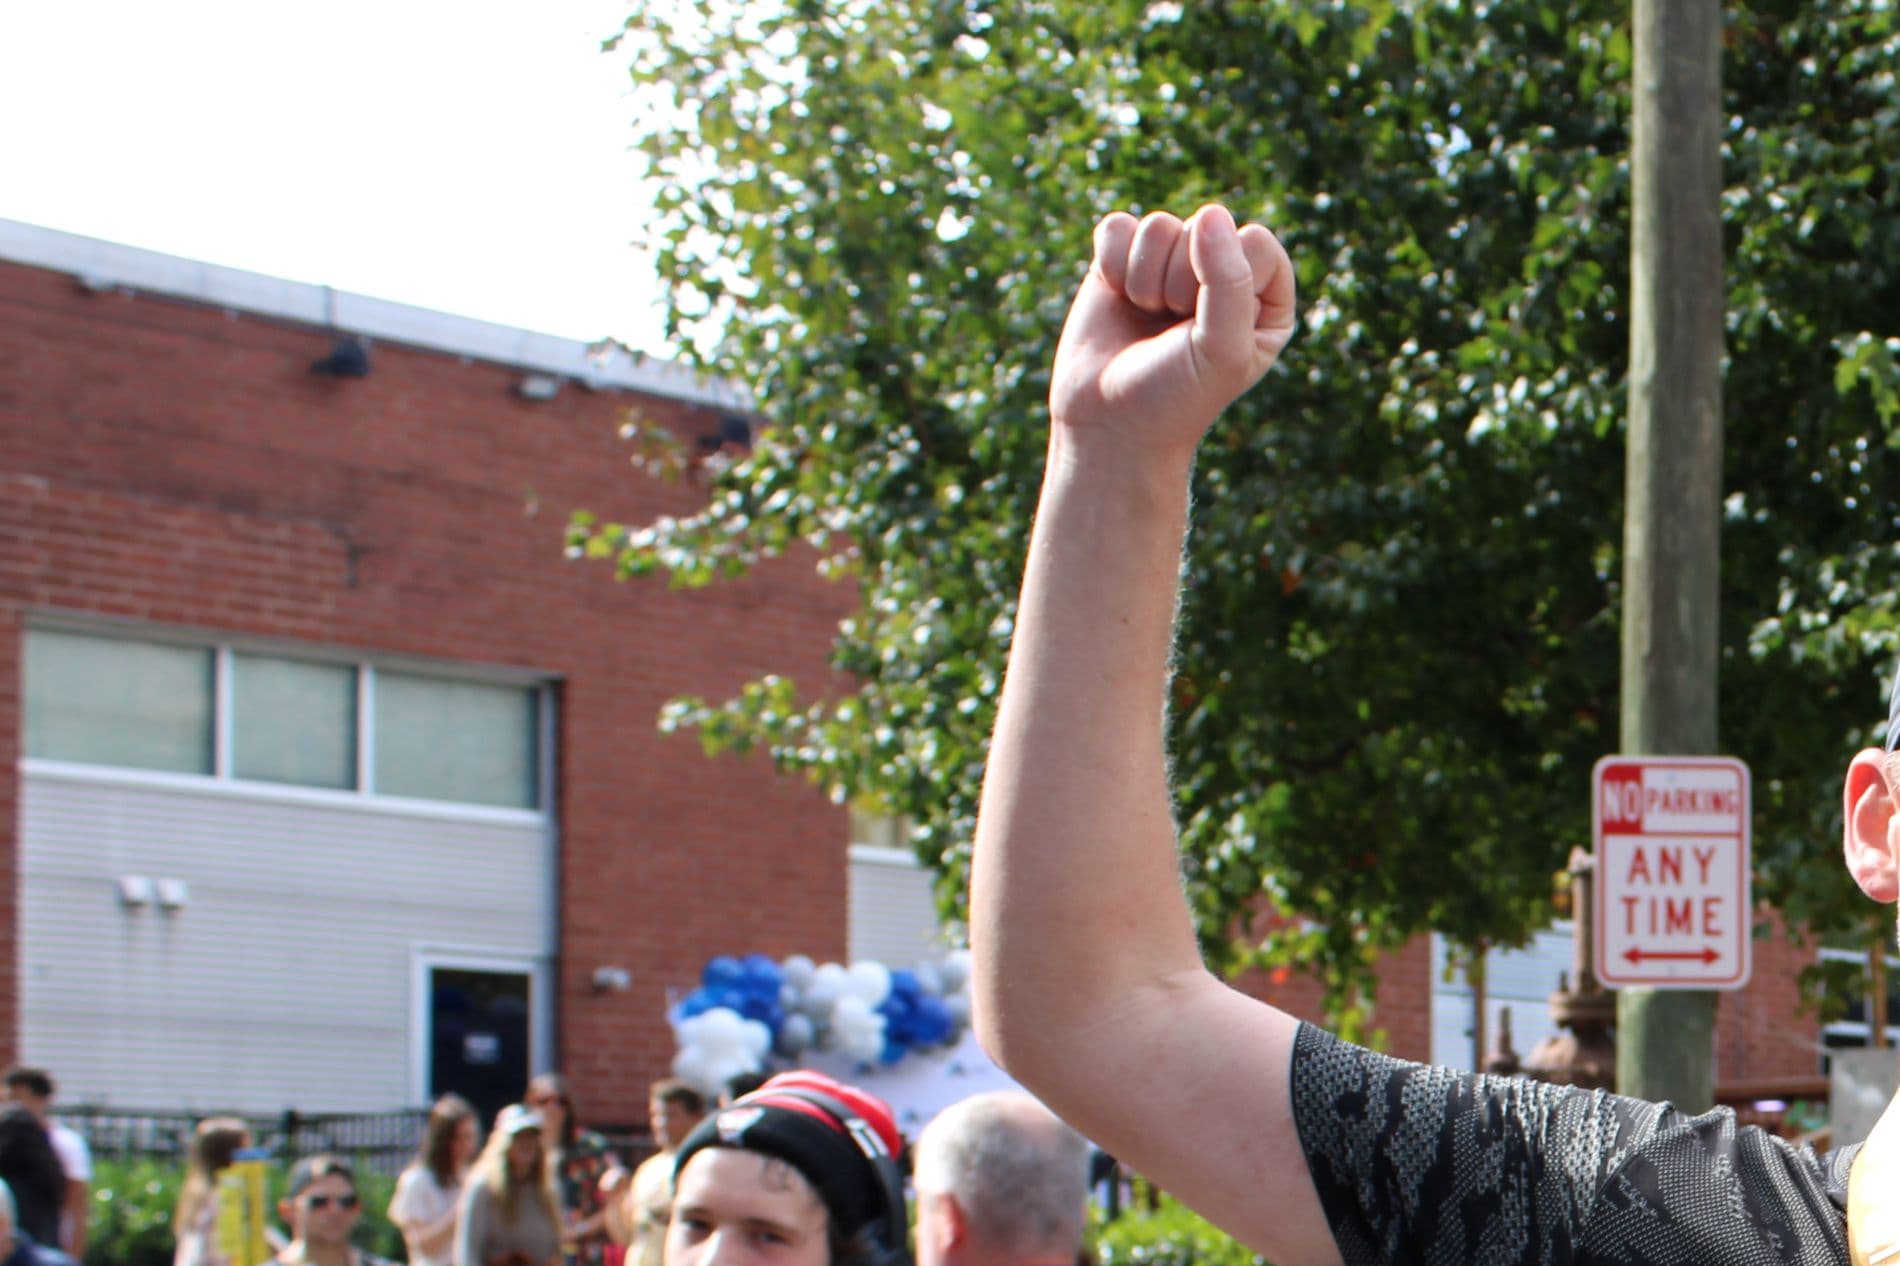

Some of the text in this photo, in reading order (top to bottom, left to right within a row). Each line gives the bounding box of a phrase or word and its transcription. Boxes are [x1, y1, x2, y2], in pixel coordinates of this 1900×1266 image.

[1602, 779, 1739, 823] NO PARKING
[1627, 846, 1716, 885] ANY
[1620, 896, 1723, 936] TIME
